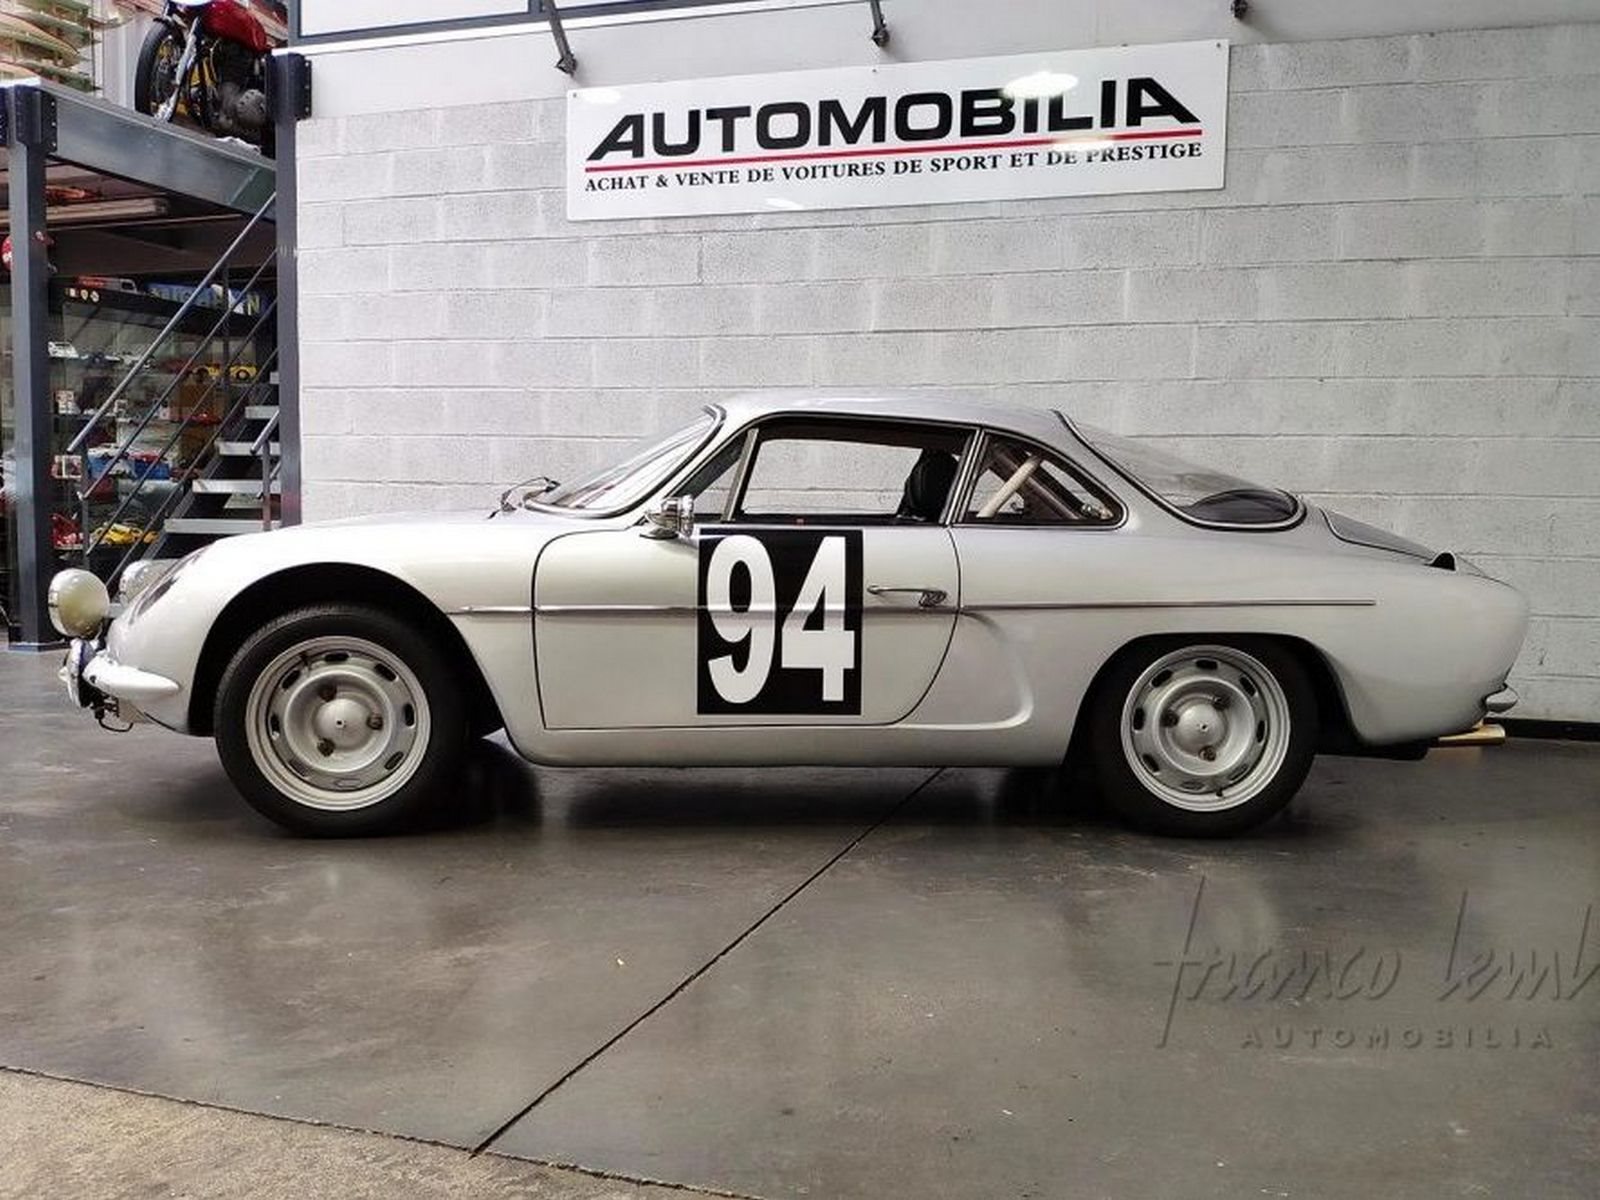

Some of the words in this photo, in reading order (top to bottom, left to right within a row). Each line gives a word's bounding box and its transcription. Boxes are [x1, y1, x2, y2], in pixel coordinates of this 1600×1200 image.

[586, 77, 1202, 162] AUTOMOBILIA
[585, 176, 649, 192] ACHAT
[655, 174, 668, 187] &
[676, 170, 740, 186] VENTE
[748, 168, 774, 183] DE
[780, 161, 886, 180] VOITURES
[893, 158, 924, 175] DE
[930, 154, 1003, 173] SPORT
[1010, 152, 1040, 168] ET
[1047, 149, 1078, 166] DE
[1085, 142, 1202, 163] PRESTIGE
[706, 534, 855, 704] 94
